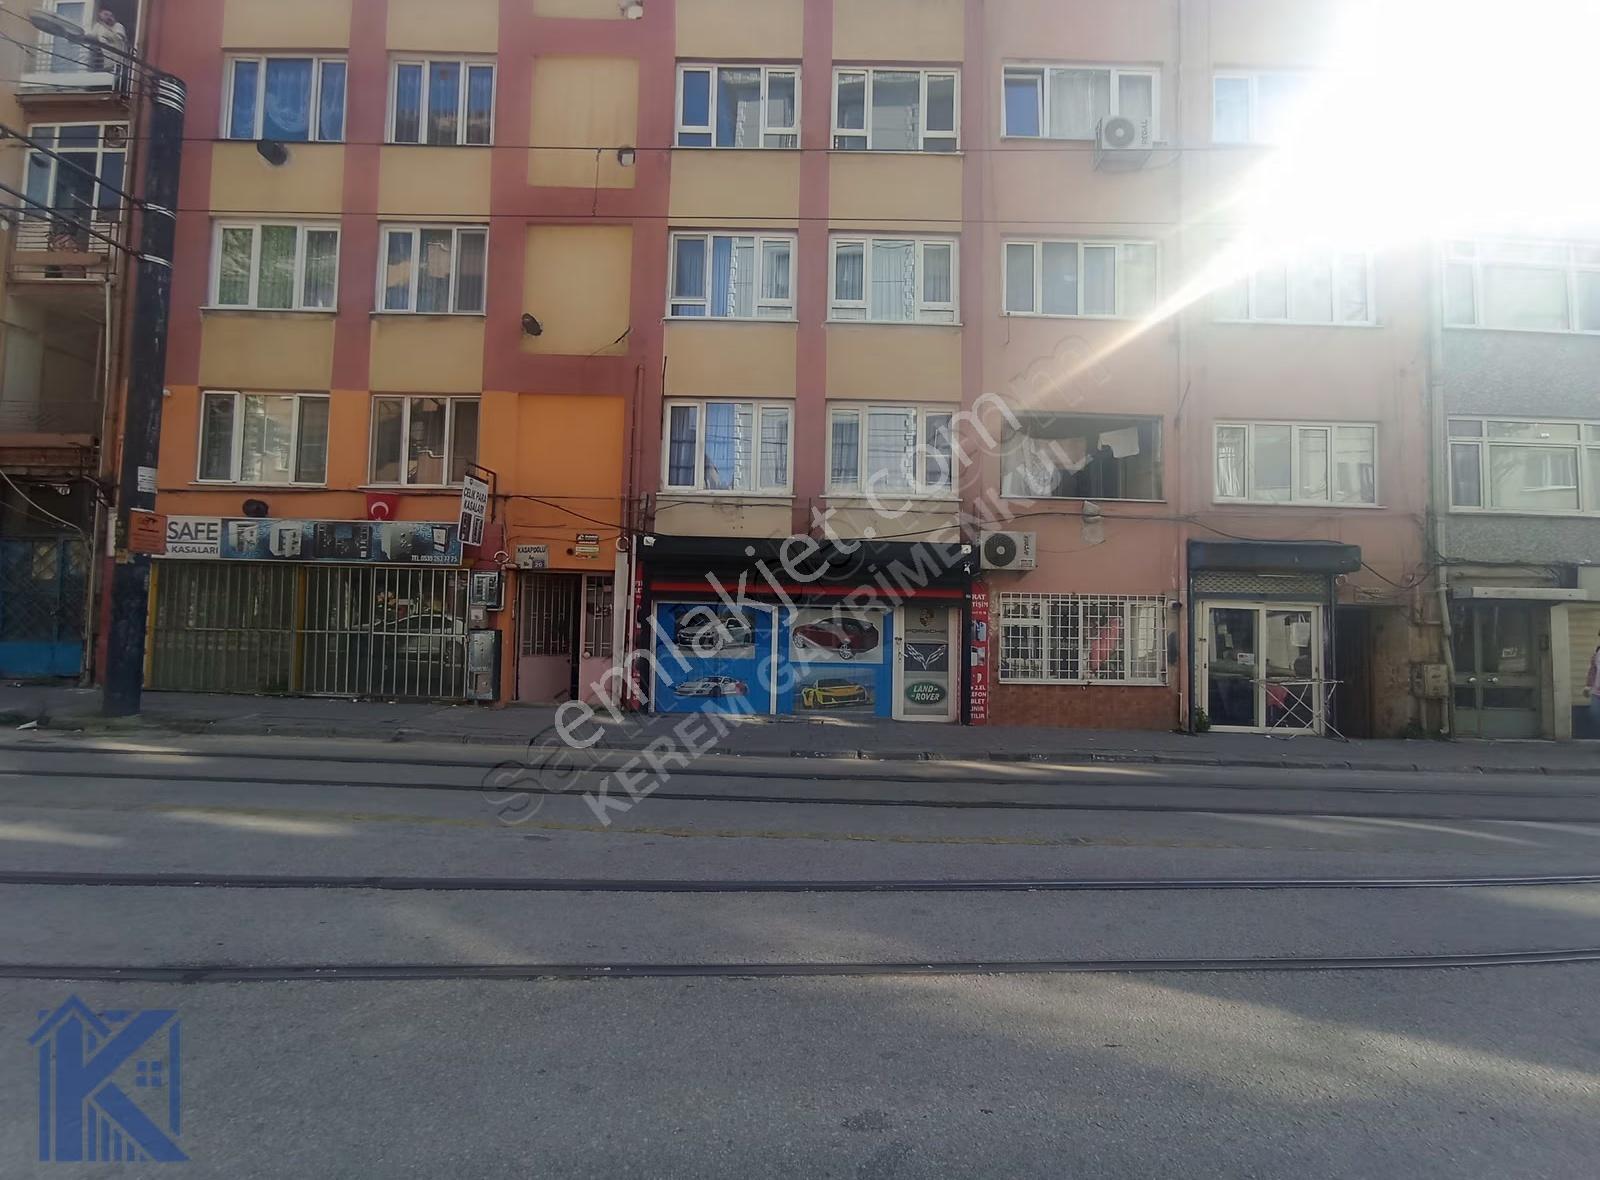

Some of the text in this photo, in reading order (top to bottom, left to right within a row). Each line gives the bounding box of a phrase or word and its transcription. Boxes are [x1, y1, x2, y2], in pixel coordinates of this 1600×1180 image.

[167, 522, 218, 540] SAFE
[171, 545, 219, 554] KASALARI
[971, 593, 987, 601] RAT
